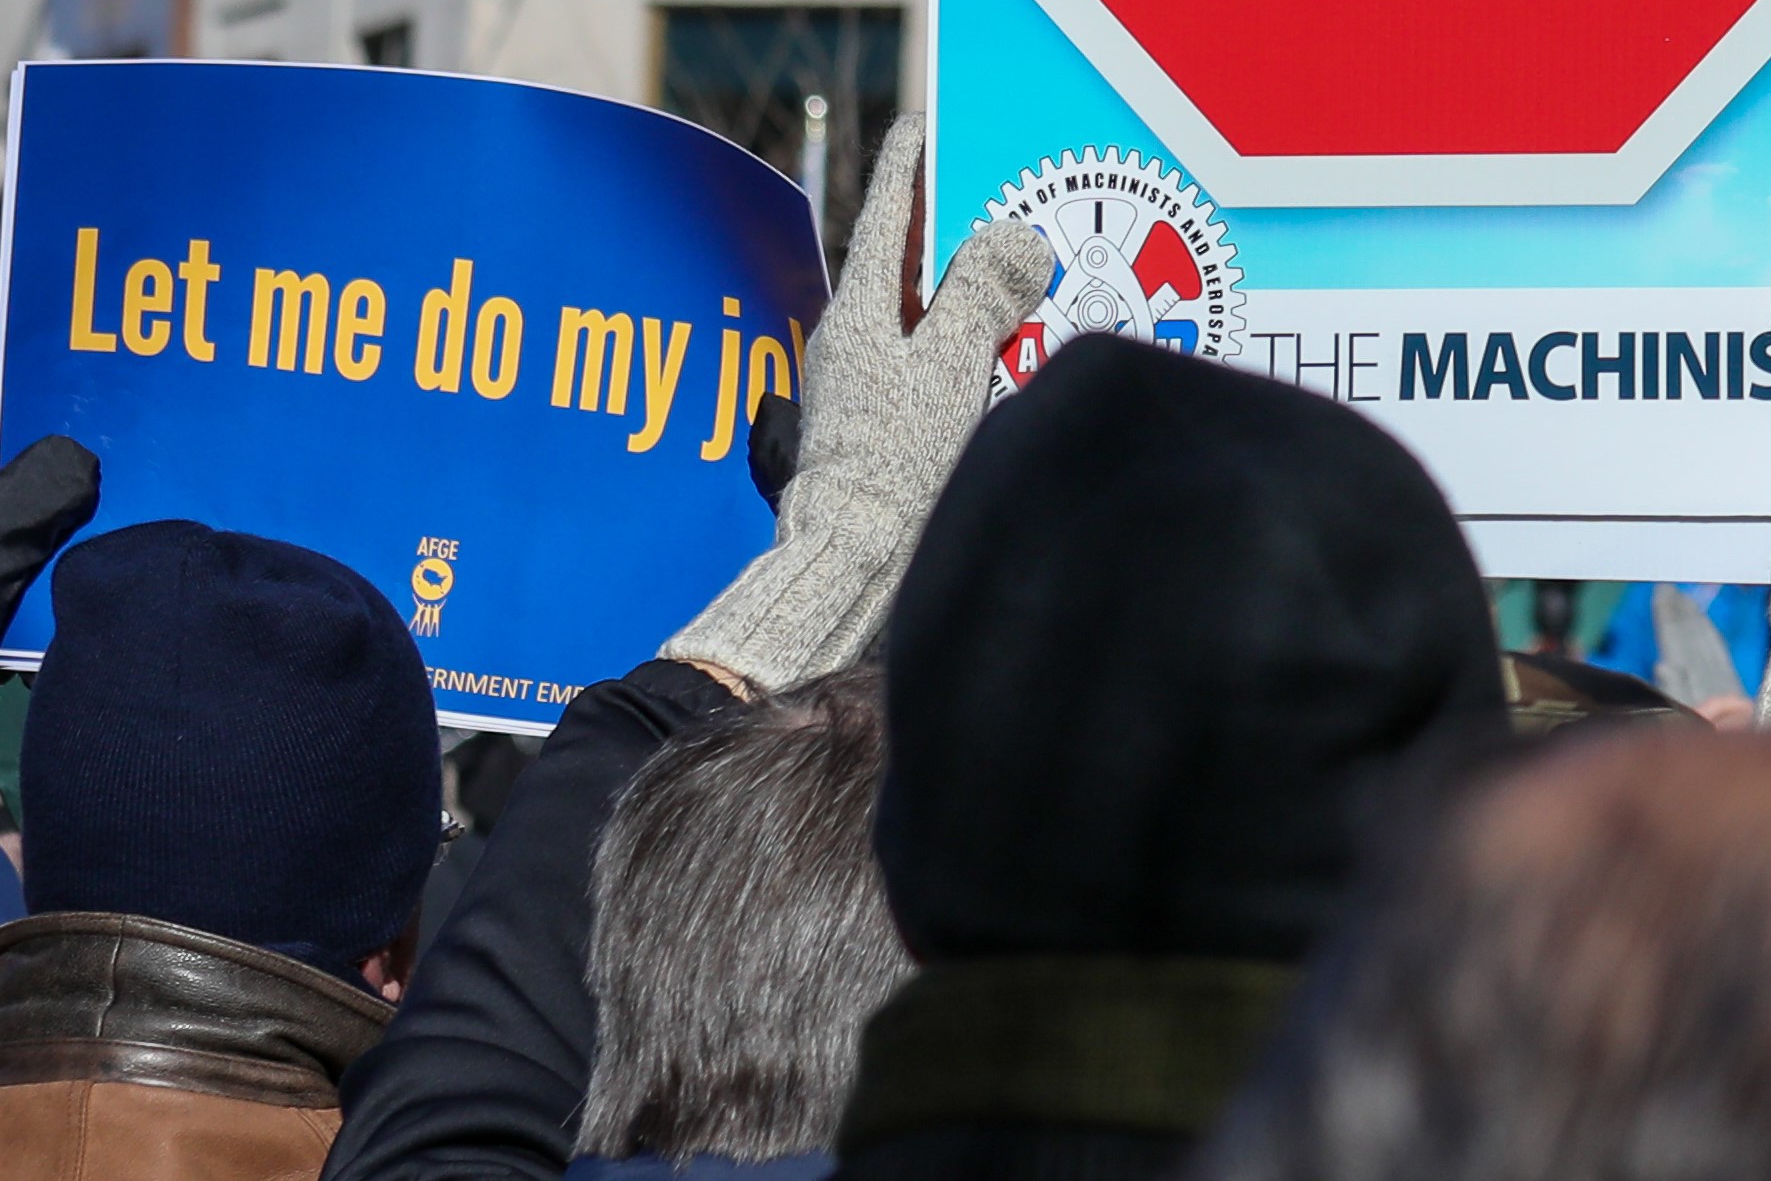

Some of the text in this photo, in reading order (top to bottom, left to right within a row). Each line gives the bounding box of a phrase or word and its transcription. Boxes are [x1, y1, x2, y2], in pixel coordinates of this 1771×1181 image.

[1036, 183, 1057, 205] OF
[1065, 172, 1181, 219] MACHINISTS
[1180, 218, 1211, 257] AND
[1201, 263, 1225, 358] AEROSPA
[69, 227, 221, 362] Let
[247, 268, 387, 382] me
[413, 257, 524, 401] do
[551, 305, 692, 453] my
[1249, 331, 1381, 402] THE
[416, 536, 460, 561] AFGE
[425, 666, 534, 701] RNMENT
